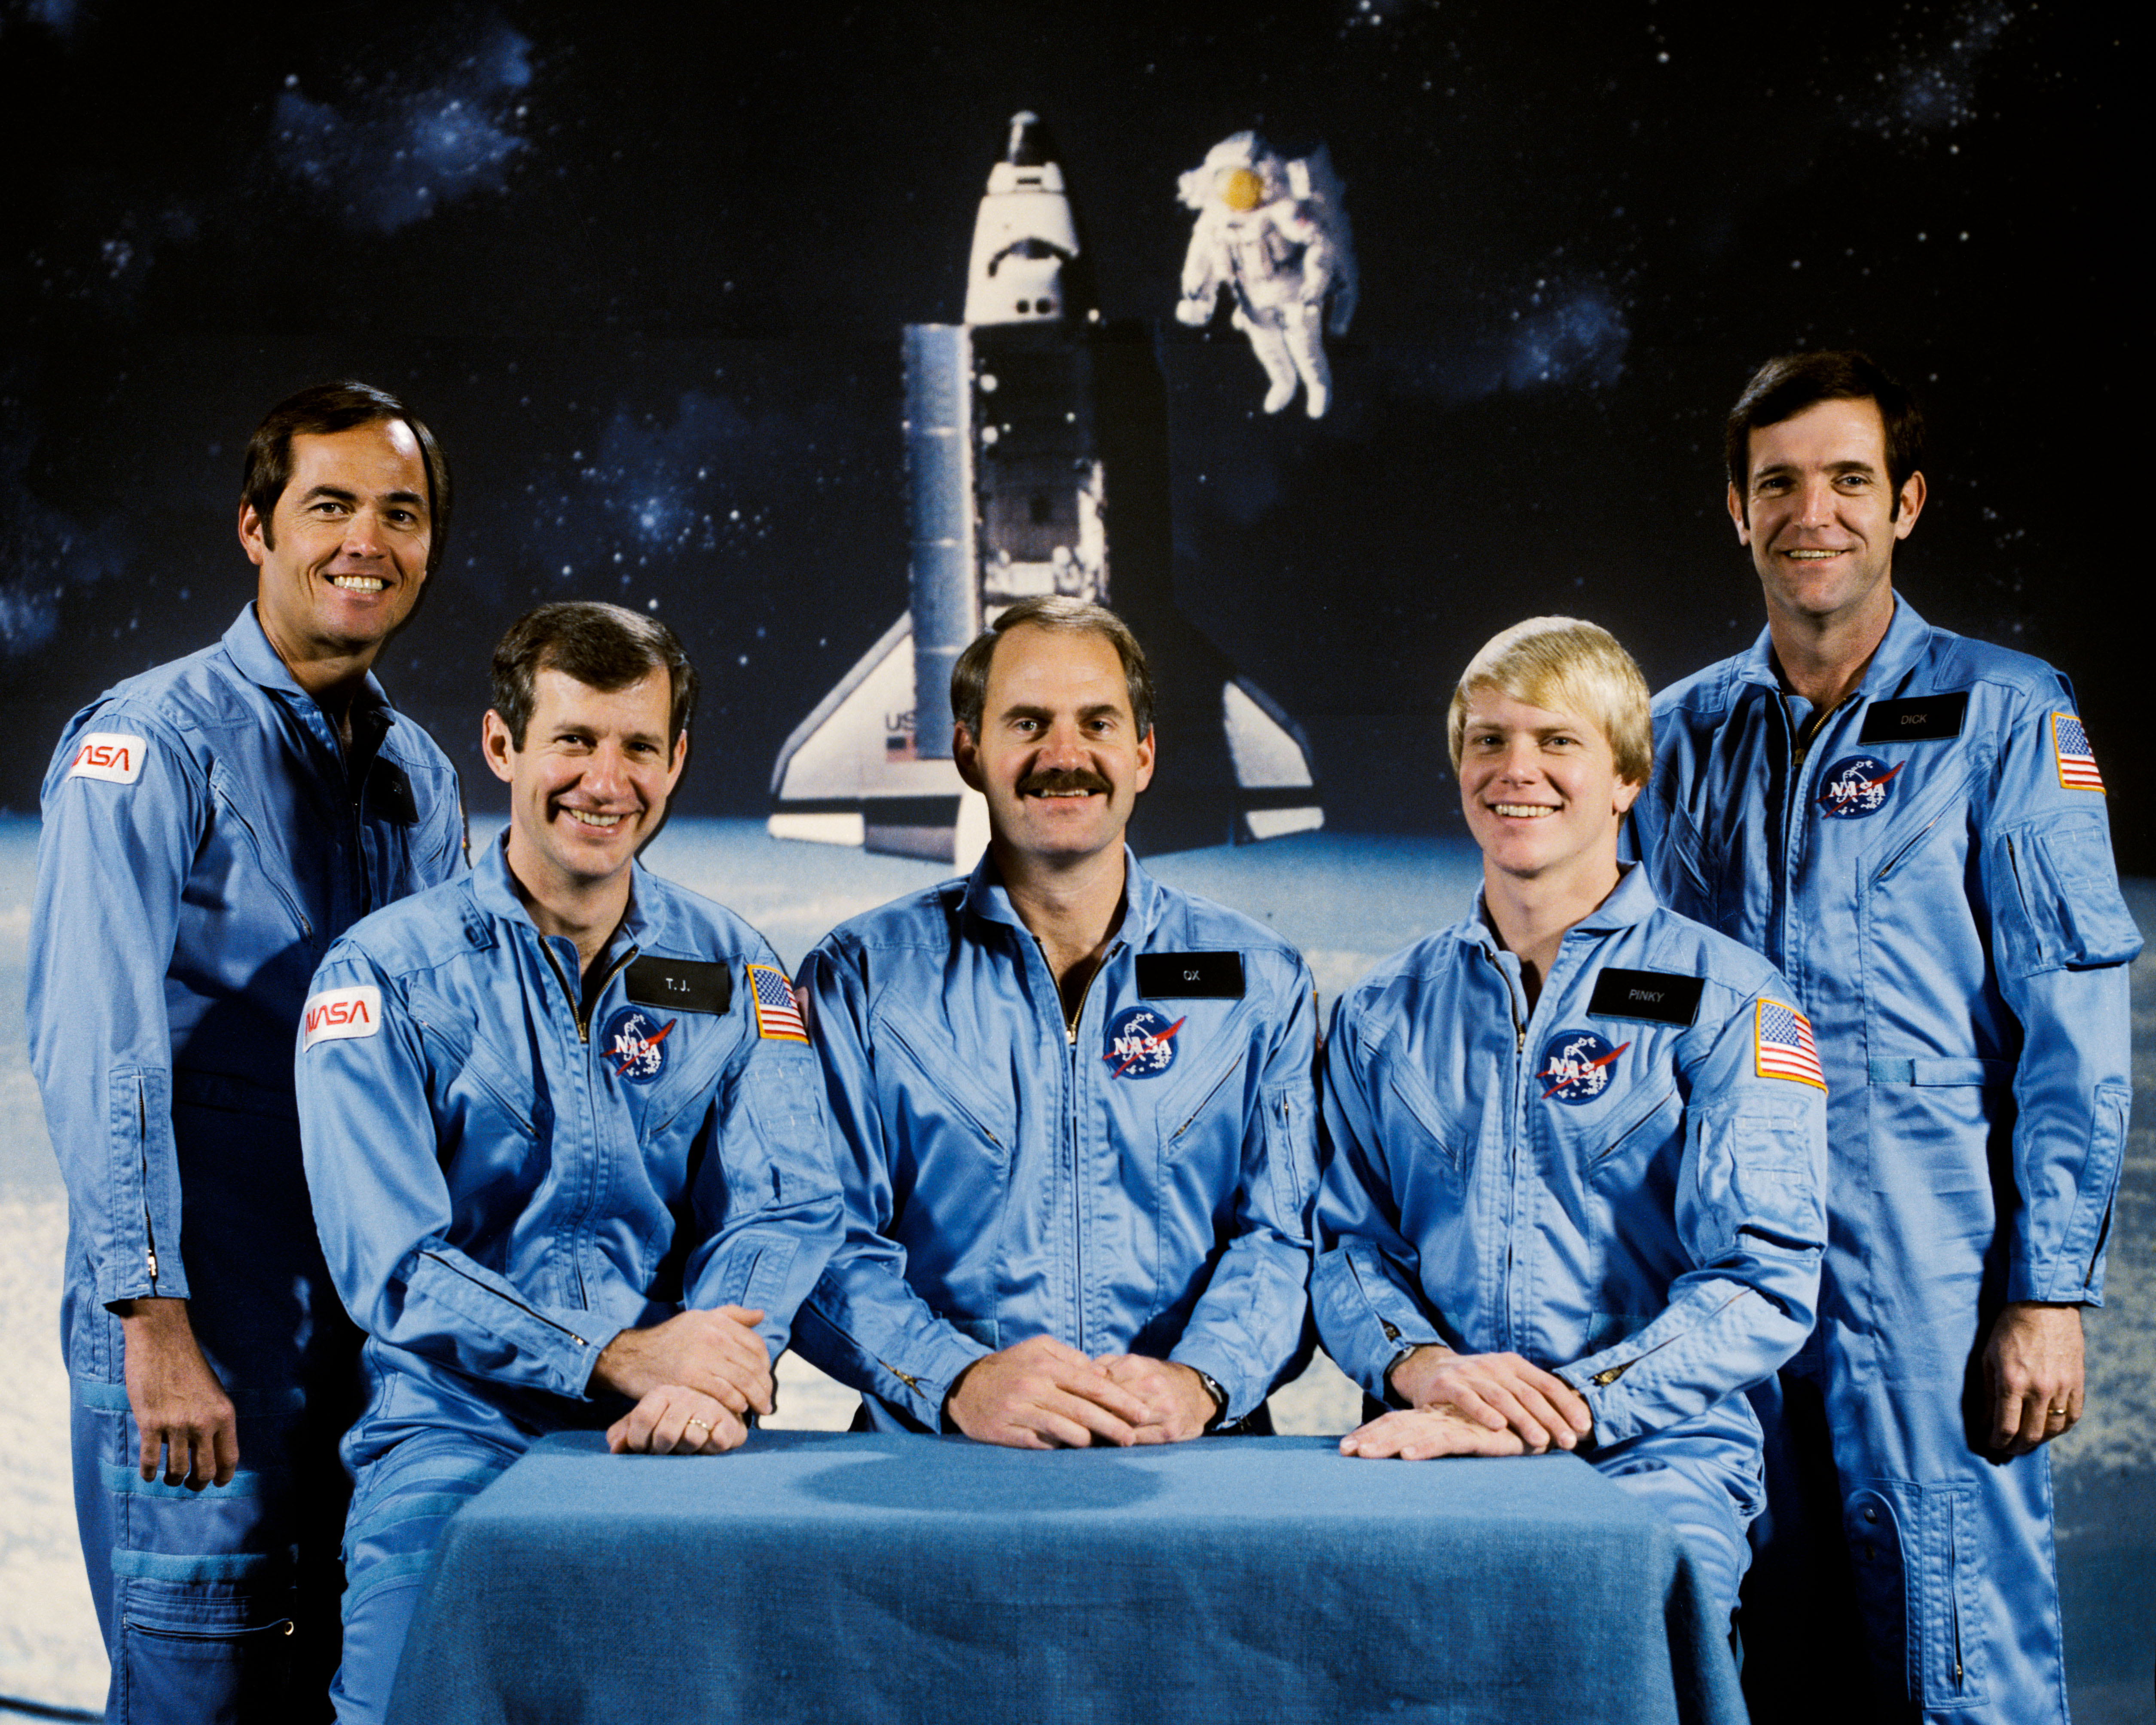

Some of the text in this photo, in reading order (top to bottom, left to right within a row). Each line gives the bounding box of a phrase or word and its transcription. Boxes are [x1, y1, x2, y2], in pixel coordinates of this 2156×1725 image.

[1901, 714, 1928, 725] DICK
[1829, 781, 1886, 797] NASA
[1183, 970, 1200, 981] OX
[666, 978, 690, 992] T.J.
[1628, 989, 1664, 1003] PINKY
[305, 1000, 370, 1037] NASA
[614, 1035, 662, 1060] NASA
[1114, 1037, 1172, 1055] NASA
[1548, 1057, 1608, 1080] NASA
